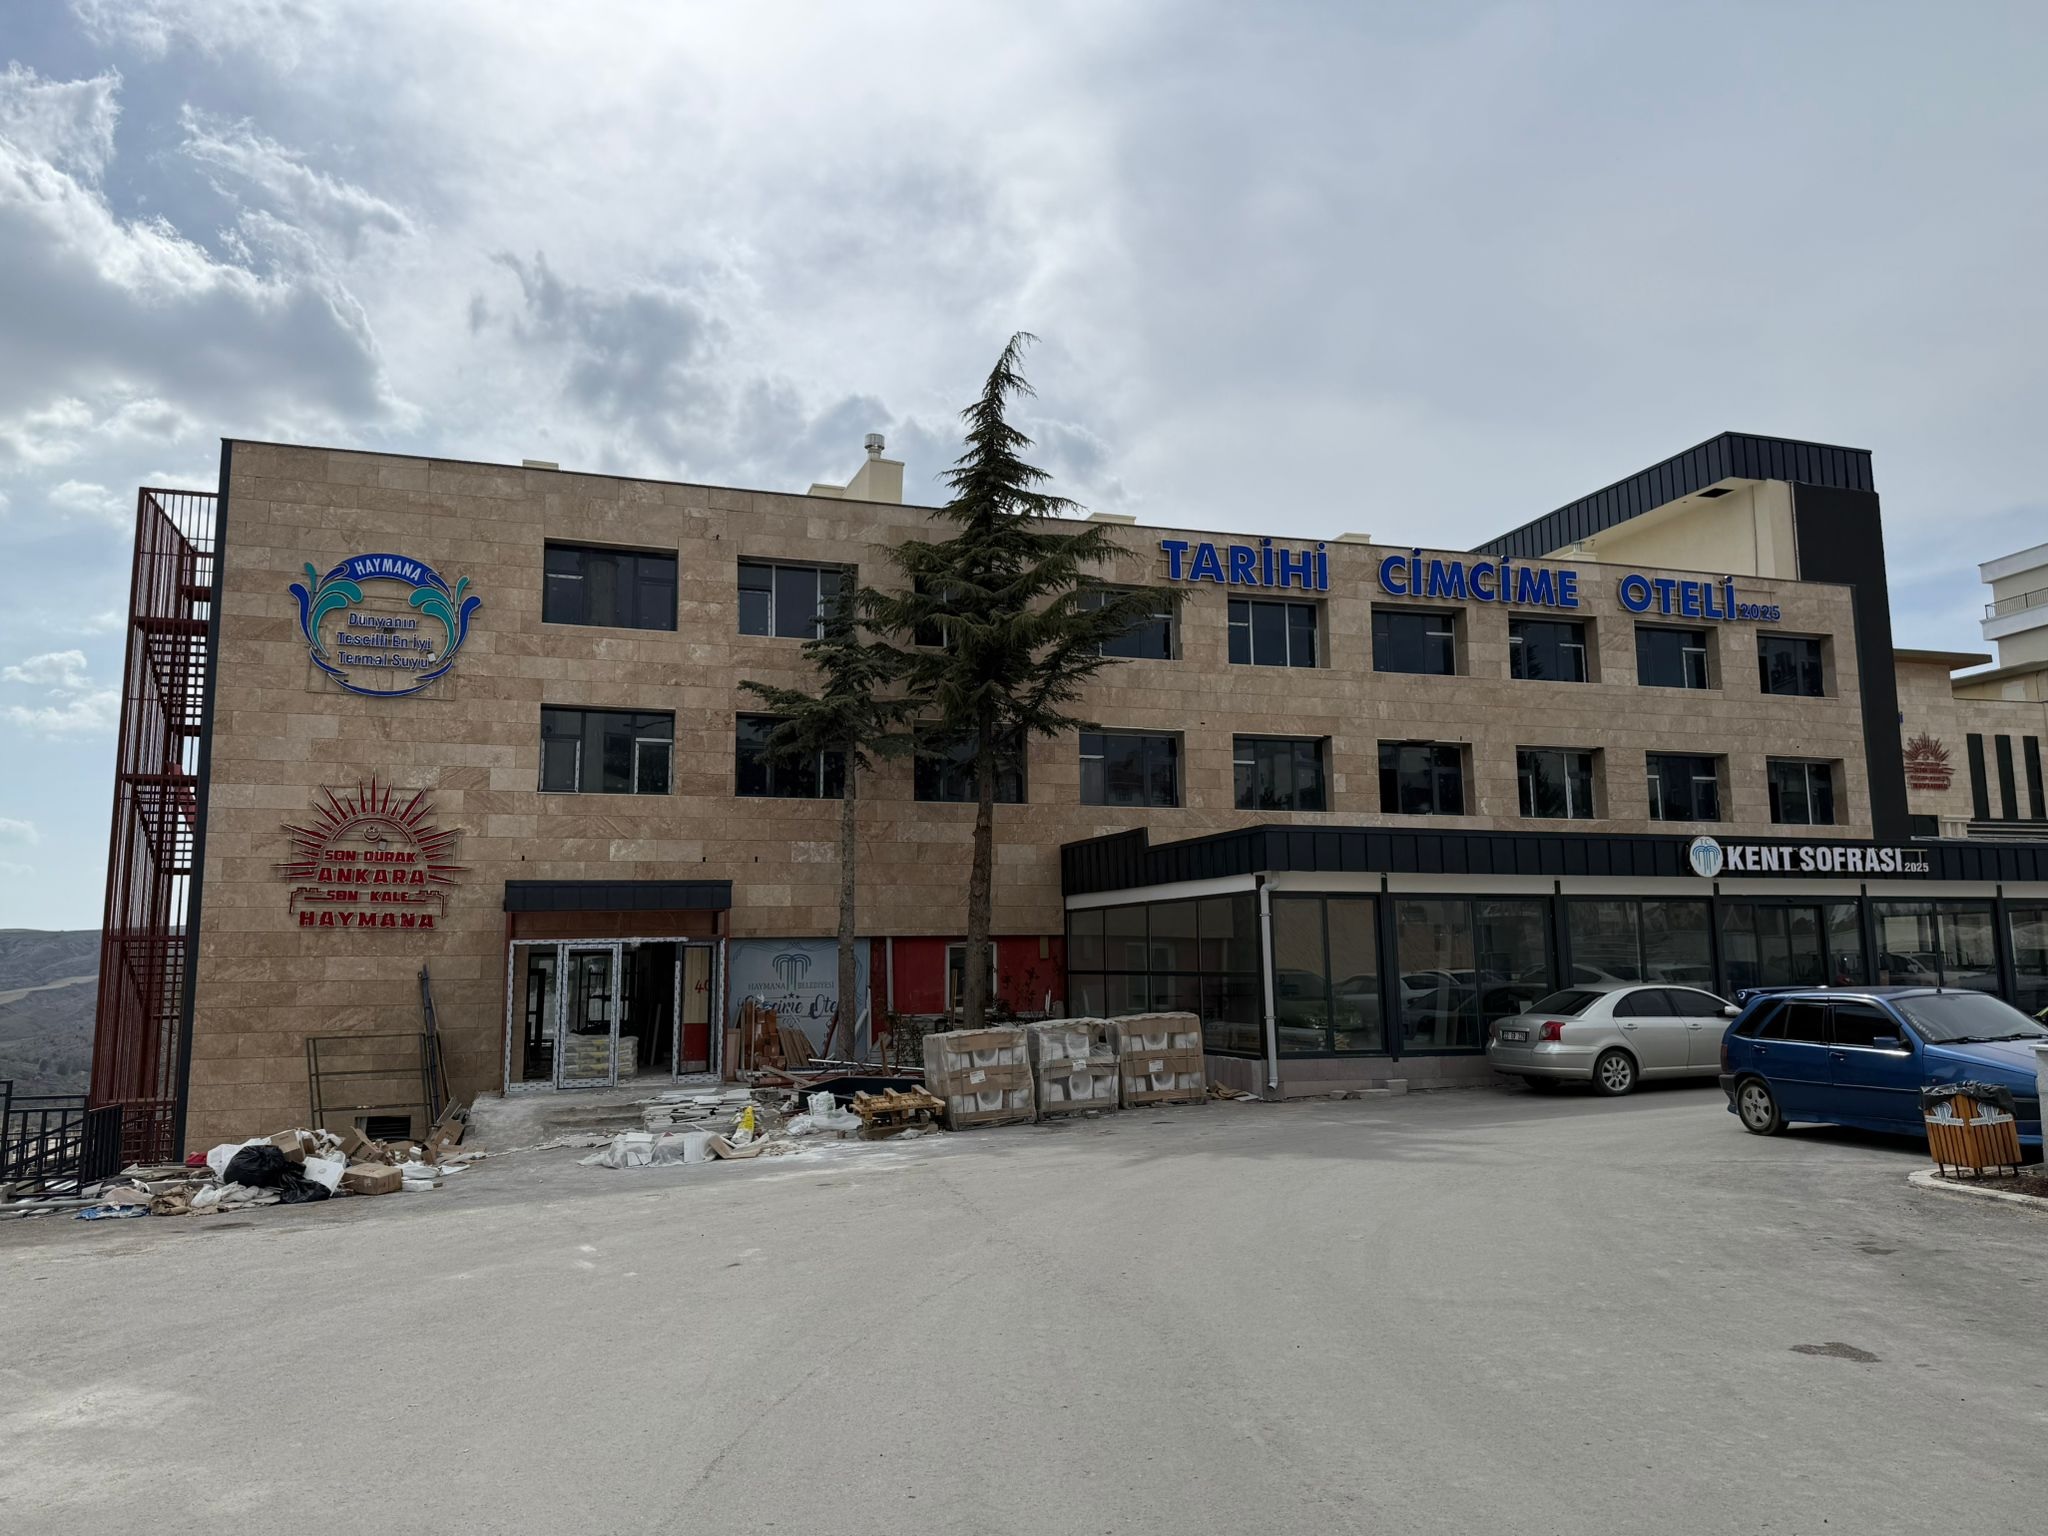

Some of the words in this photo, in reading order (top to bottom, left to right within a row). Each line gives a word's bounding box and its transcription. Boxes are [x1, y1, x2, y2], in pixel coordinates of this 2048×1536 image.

[354, 558, 422, 581] HAYMANA
[1161, 537, 1329, 591] TARİHİ
[1378, 548, 1580, 608] CİMCİME
[1620, 573, 1737, 620] OTELİ
[1740, 603, 1782, 623] 2025
[348, 612, 417, 630] Dünyanın
[336, 631, 389, 648] Tescilli
[392, 635, 408, 647] En
[413, 634, 432, 651] İyi
[338, 651, 388, 667] Termal
[392, 653, 429, 670] Suyu
[324, 850, 356, 862] SON
[363, 851, 416, 863] DURAK
[1727, 846, 1793, 871] KENT
[1799, 846, 1902, 873] SOFRASI
[1904, 862, 1929, 873] 2025
[317, 867, 426, 885] ANKARA
[326, 890, 358, 902] SON
[369, 890, 409, 902] KALE
[299, 911, 434, 928] HAYMANA
[748, 981, 786, 991] HAYMANA
